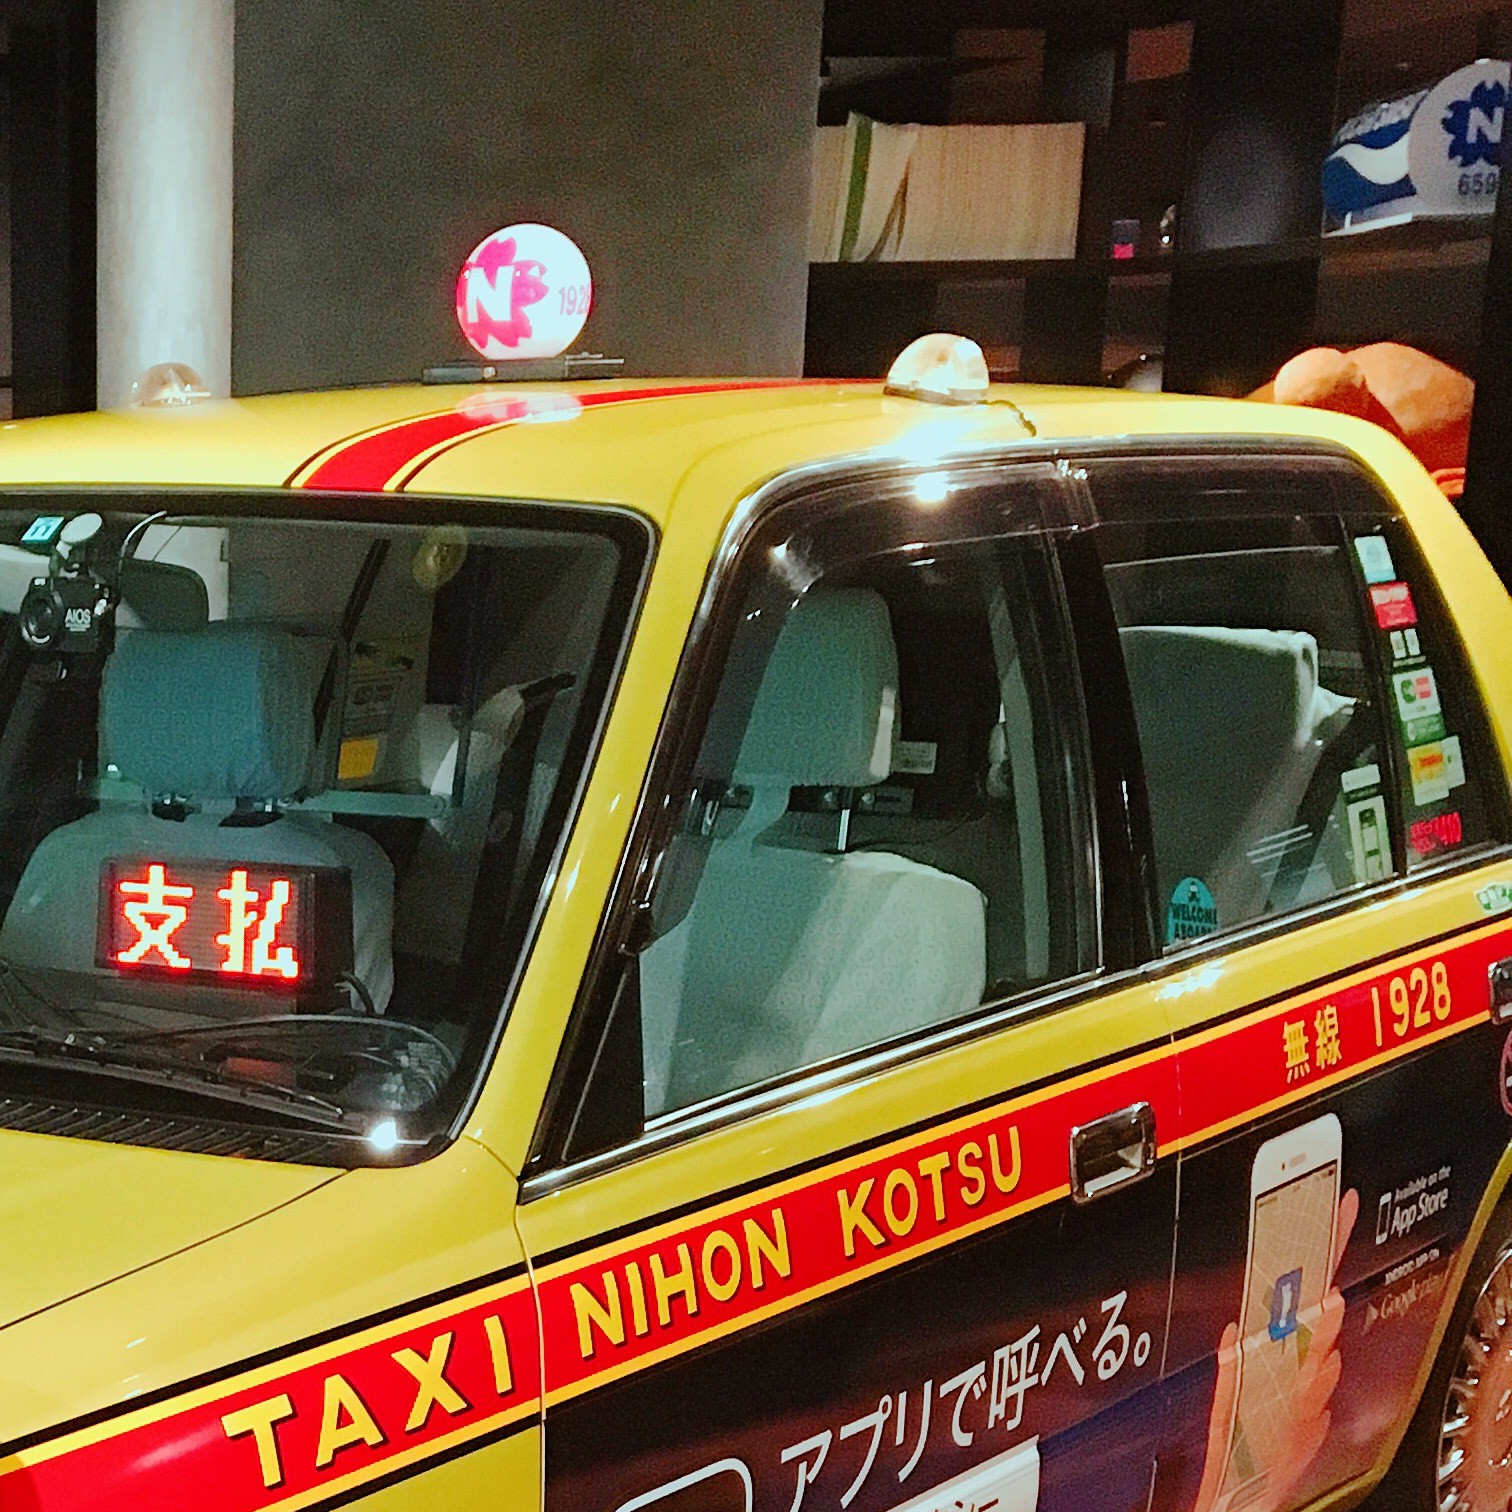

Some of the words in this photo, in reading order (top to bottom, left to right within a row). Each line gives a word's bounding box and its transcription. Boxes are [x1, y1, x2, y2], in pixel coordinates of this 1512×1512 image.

[1466, 106, 1505, 144] N
[466, 265, 514, 322] N
[558, 284, 591, 317] 192
[117, 864, 299, 979] 支払
[1282, 1003, 1342, 1084] 無線
[1370, 960, 1452, 1047] 1928
[1390, 1203, 1417, 1238] App
[1416, 1187, 1449, 1222] Store
[220, 1315, 514, 1489] TAXI
[571, 1208, 792, 1359] NIHON
[840, 1126, 1025, 1260] KOTSU
